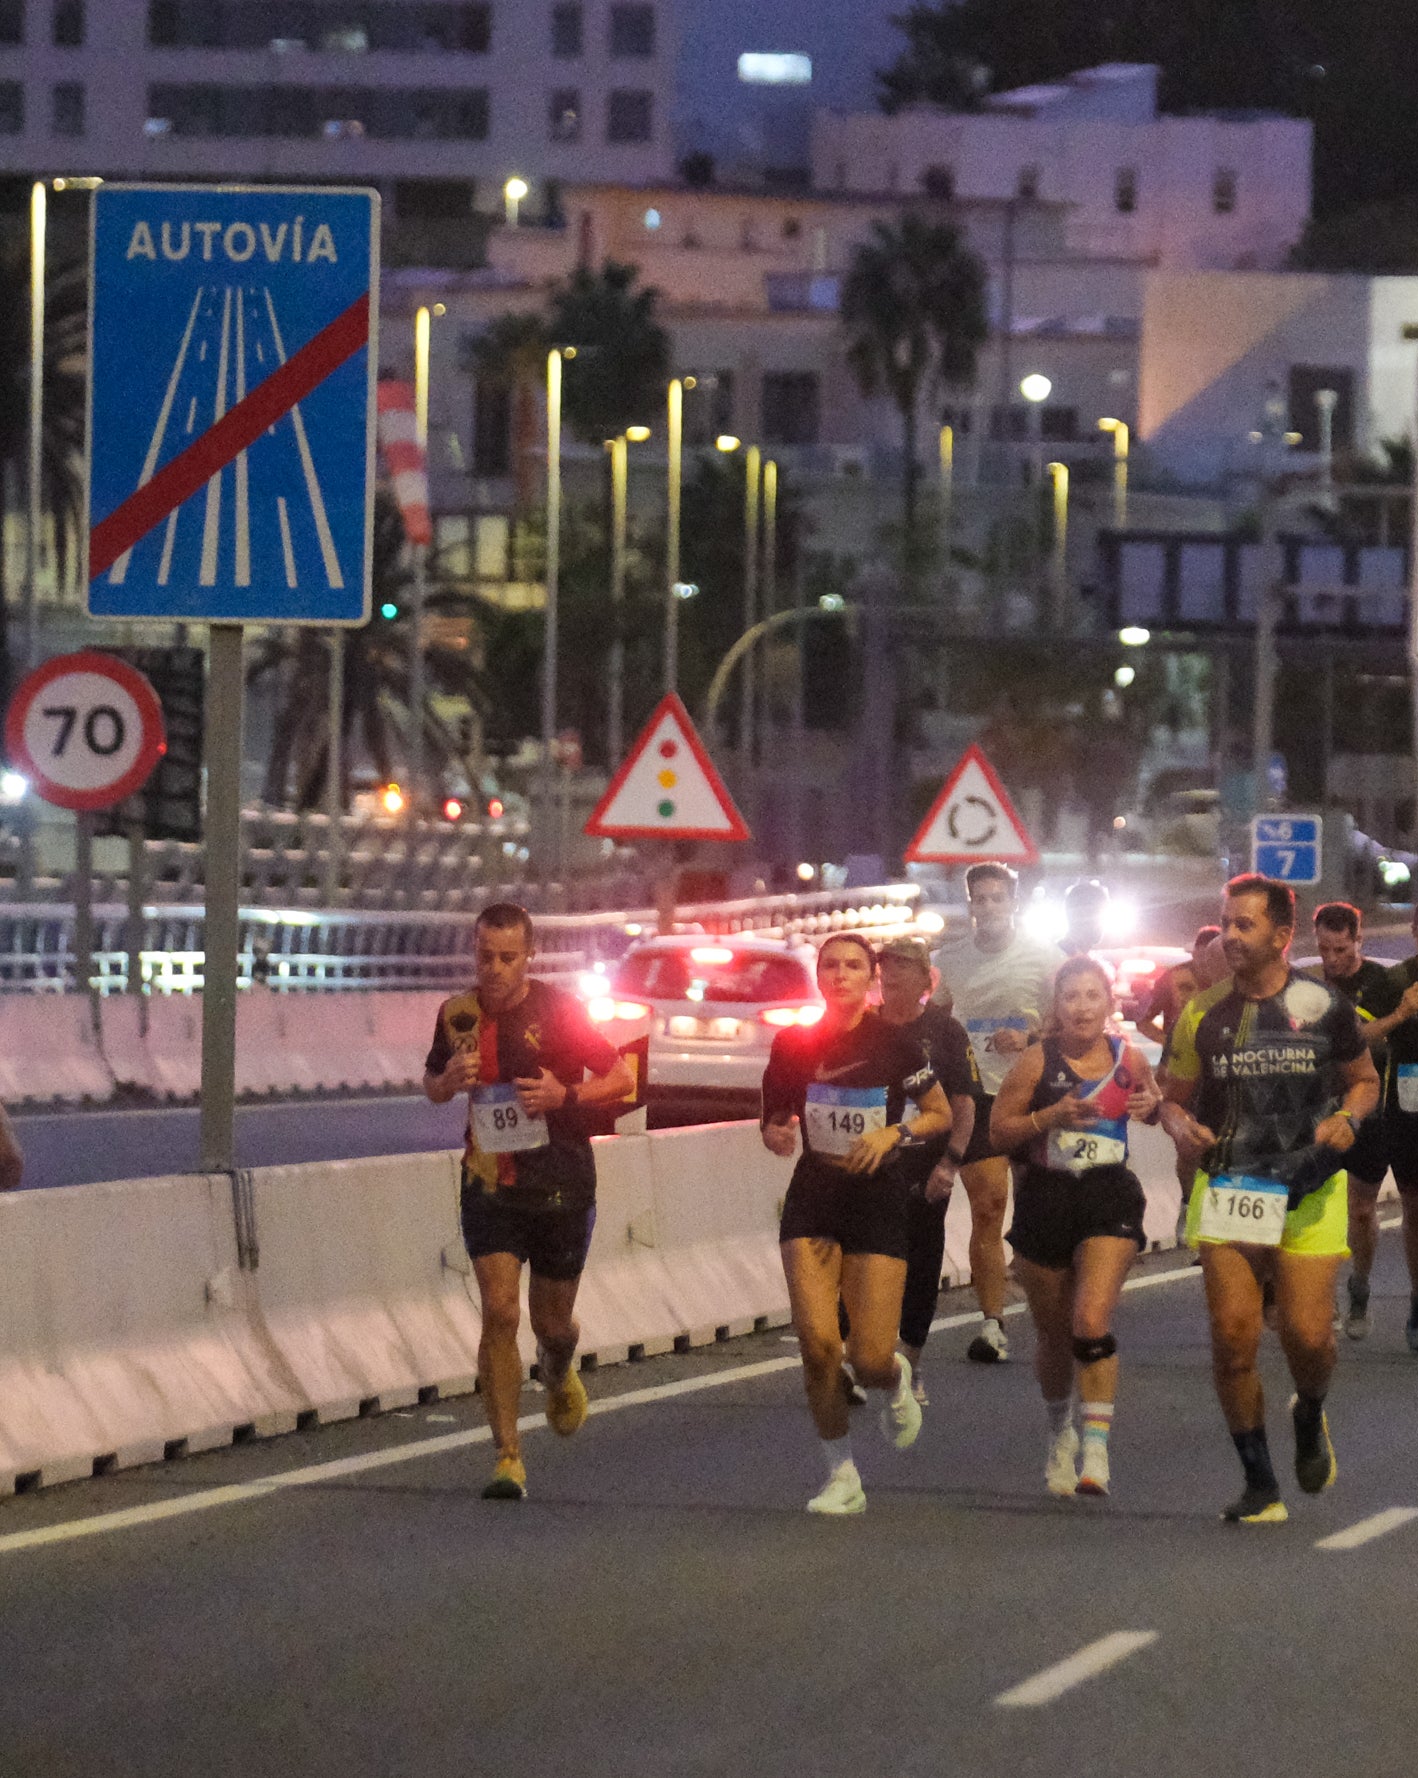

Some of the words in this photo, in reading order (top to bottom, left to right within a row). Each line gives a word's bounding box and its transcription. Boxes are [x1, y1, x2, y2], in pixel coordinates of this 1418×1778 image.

[126, 215, 338, 262] AUTOVÍA
[42, 704, 125, 756] 70
[1277, 850, 1296, 877] 7
[1232, 1047, 1316, 1063] NOCTURNA
[1232, 1061, 1316, 1077] VALENCINA
[493, 1106, 518, 1130] 89
[828, 1111, 865, 1135] 149
[1073, 1138, 1098, 1161] 28
[1227, 1195, 1265, 1221] 166
